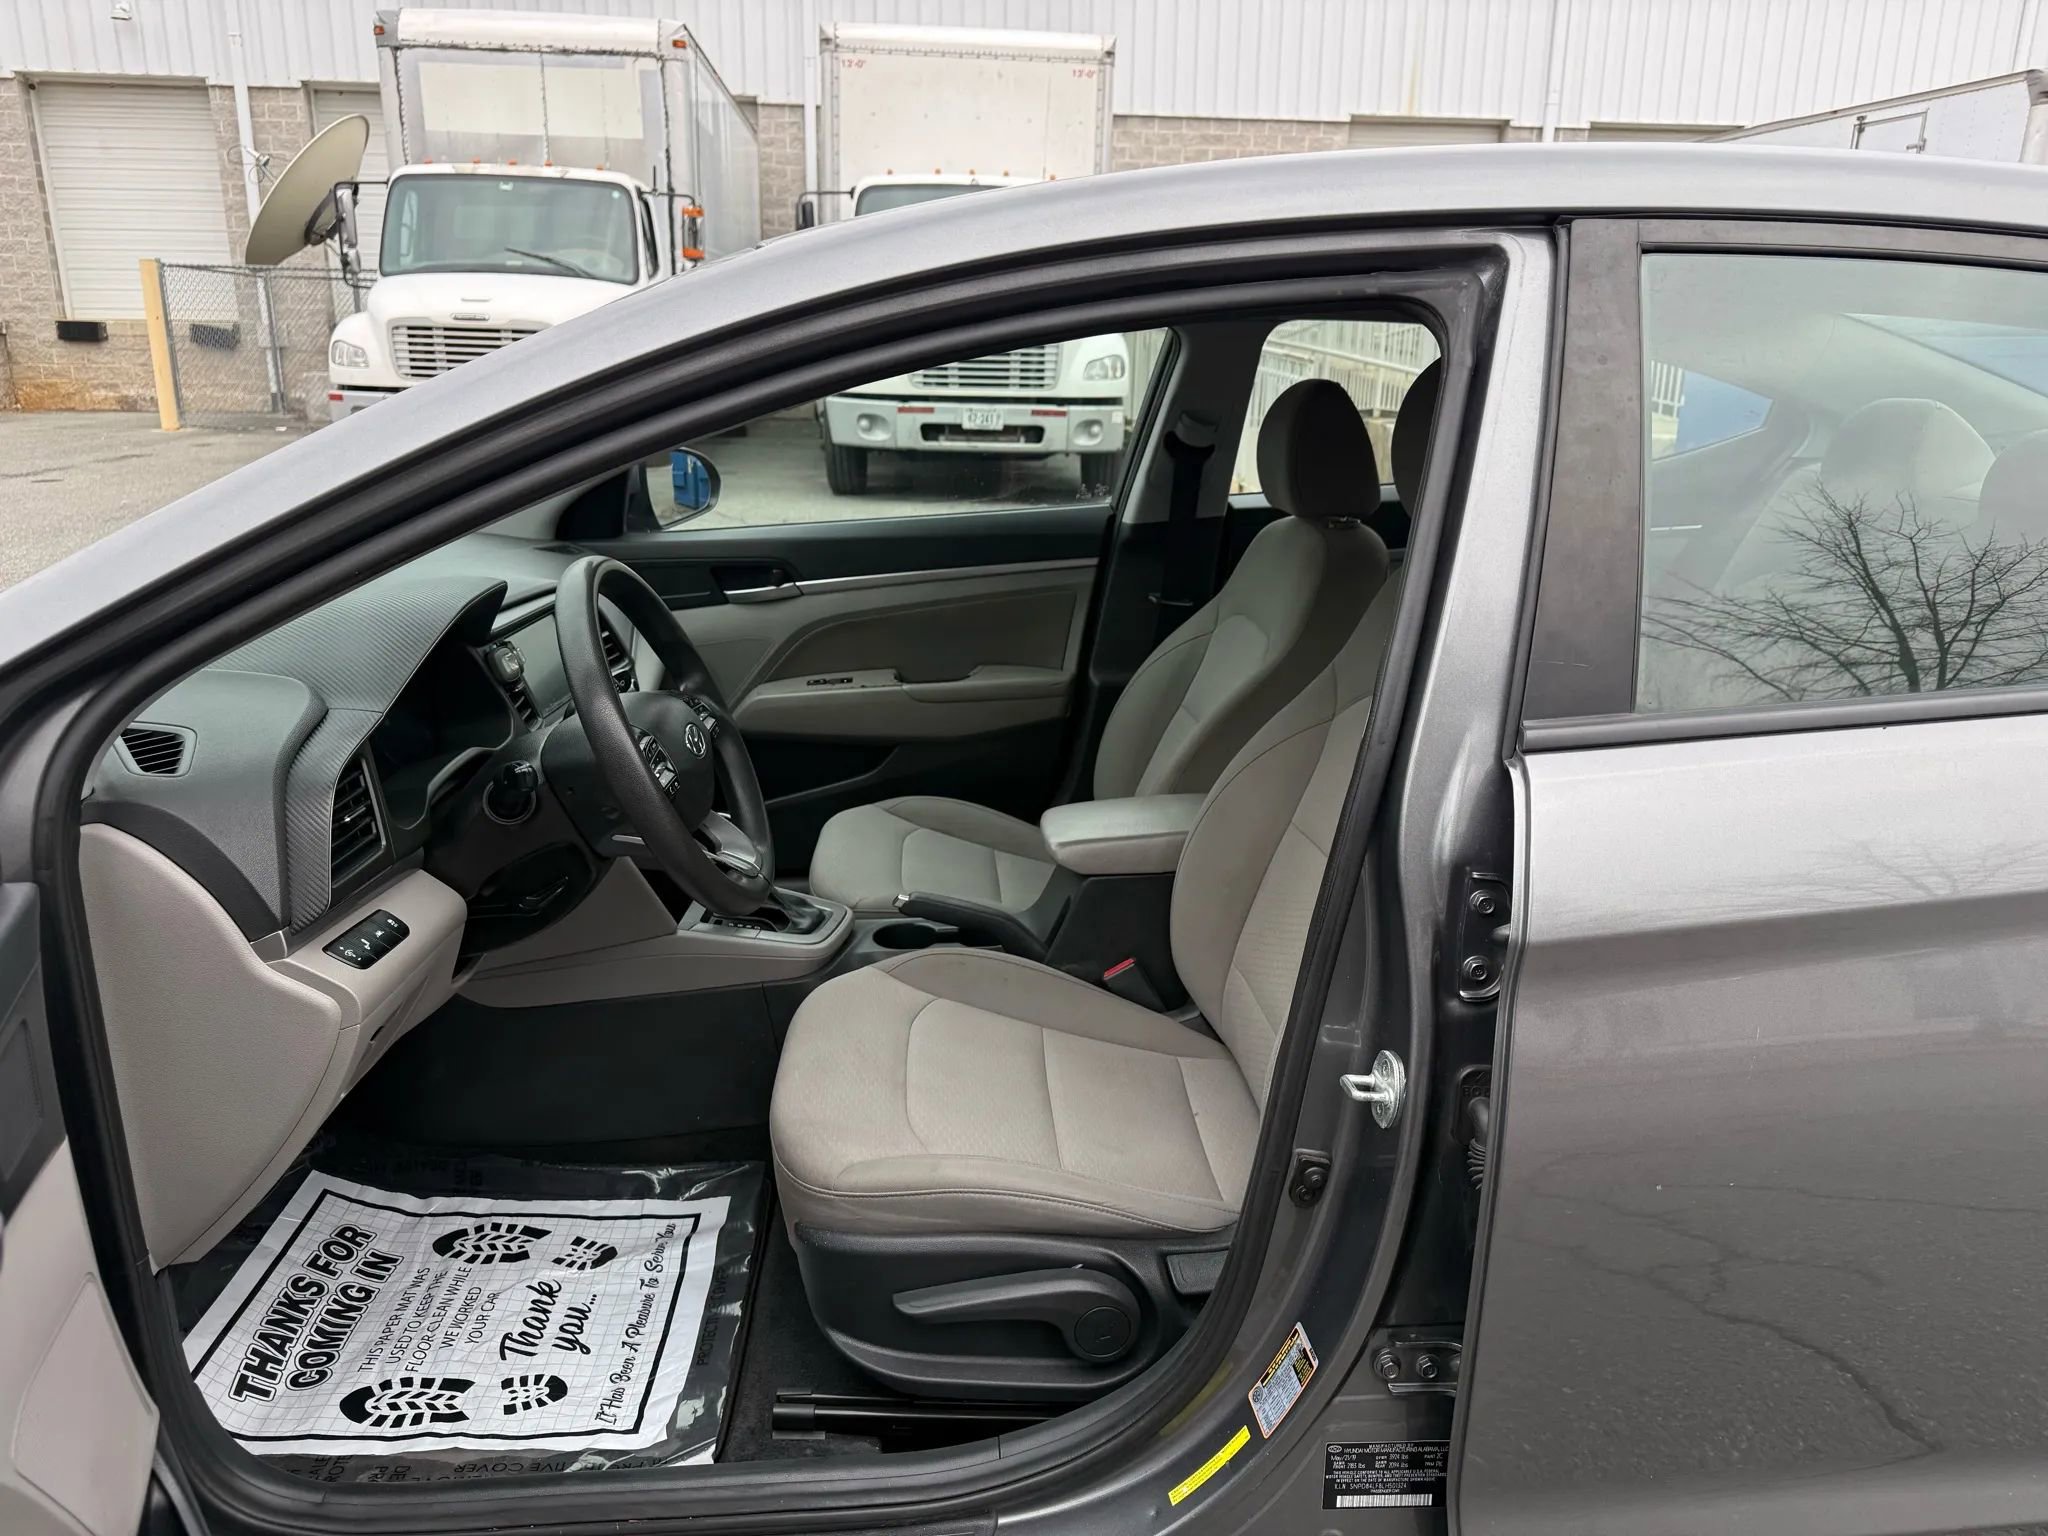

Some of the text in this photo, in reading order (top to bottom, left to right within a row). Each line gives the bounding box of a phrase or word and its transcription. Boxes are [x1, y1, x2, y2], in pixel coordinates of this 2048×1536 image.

[655, 1223, 676, 1242] You
[228, 1224, 377, 1402] THANKS FOR
[640, 1277, 660, 1290] To
[285, 1282, 380, 1390] COMING
[350, 1248, 404, 1282] IN
[358, 1268, 430, 1372] THIS PAPER MAT WAS
[386, 1271, 448, 1363] USED TO KEEP THE
[405, 1267, 472, 1372] FLOOR CLEAN WHILE
[439, 1287, 481, 1349] WE WORKED
[465, 1293, 499, 1343] YOUR CAR
[500, 1279, 561, 1360] Thank
[552, 1294, 597, 1355] you...
[626, 1292, 655, 1338] Pleasure
[609, 1356, 636, 1384] Been
[622, 1340, 642, 1353] A
[600, 1387, 625, 1410] Has
